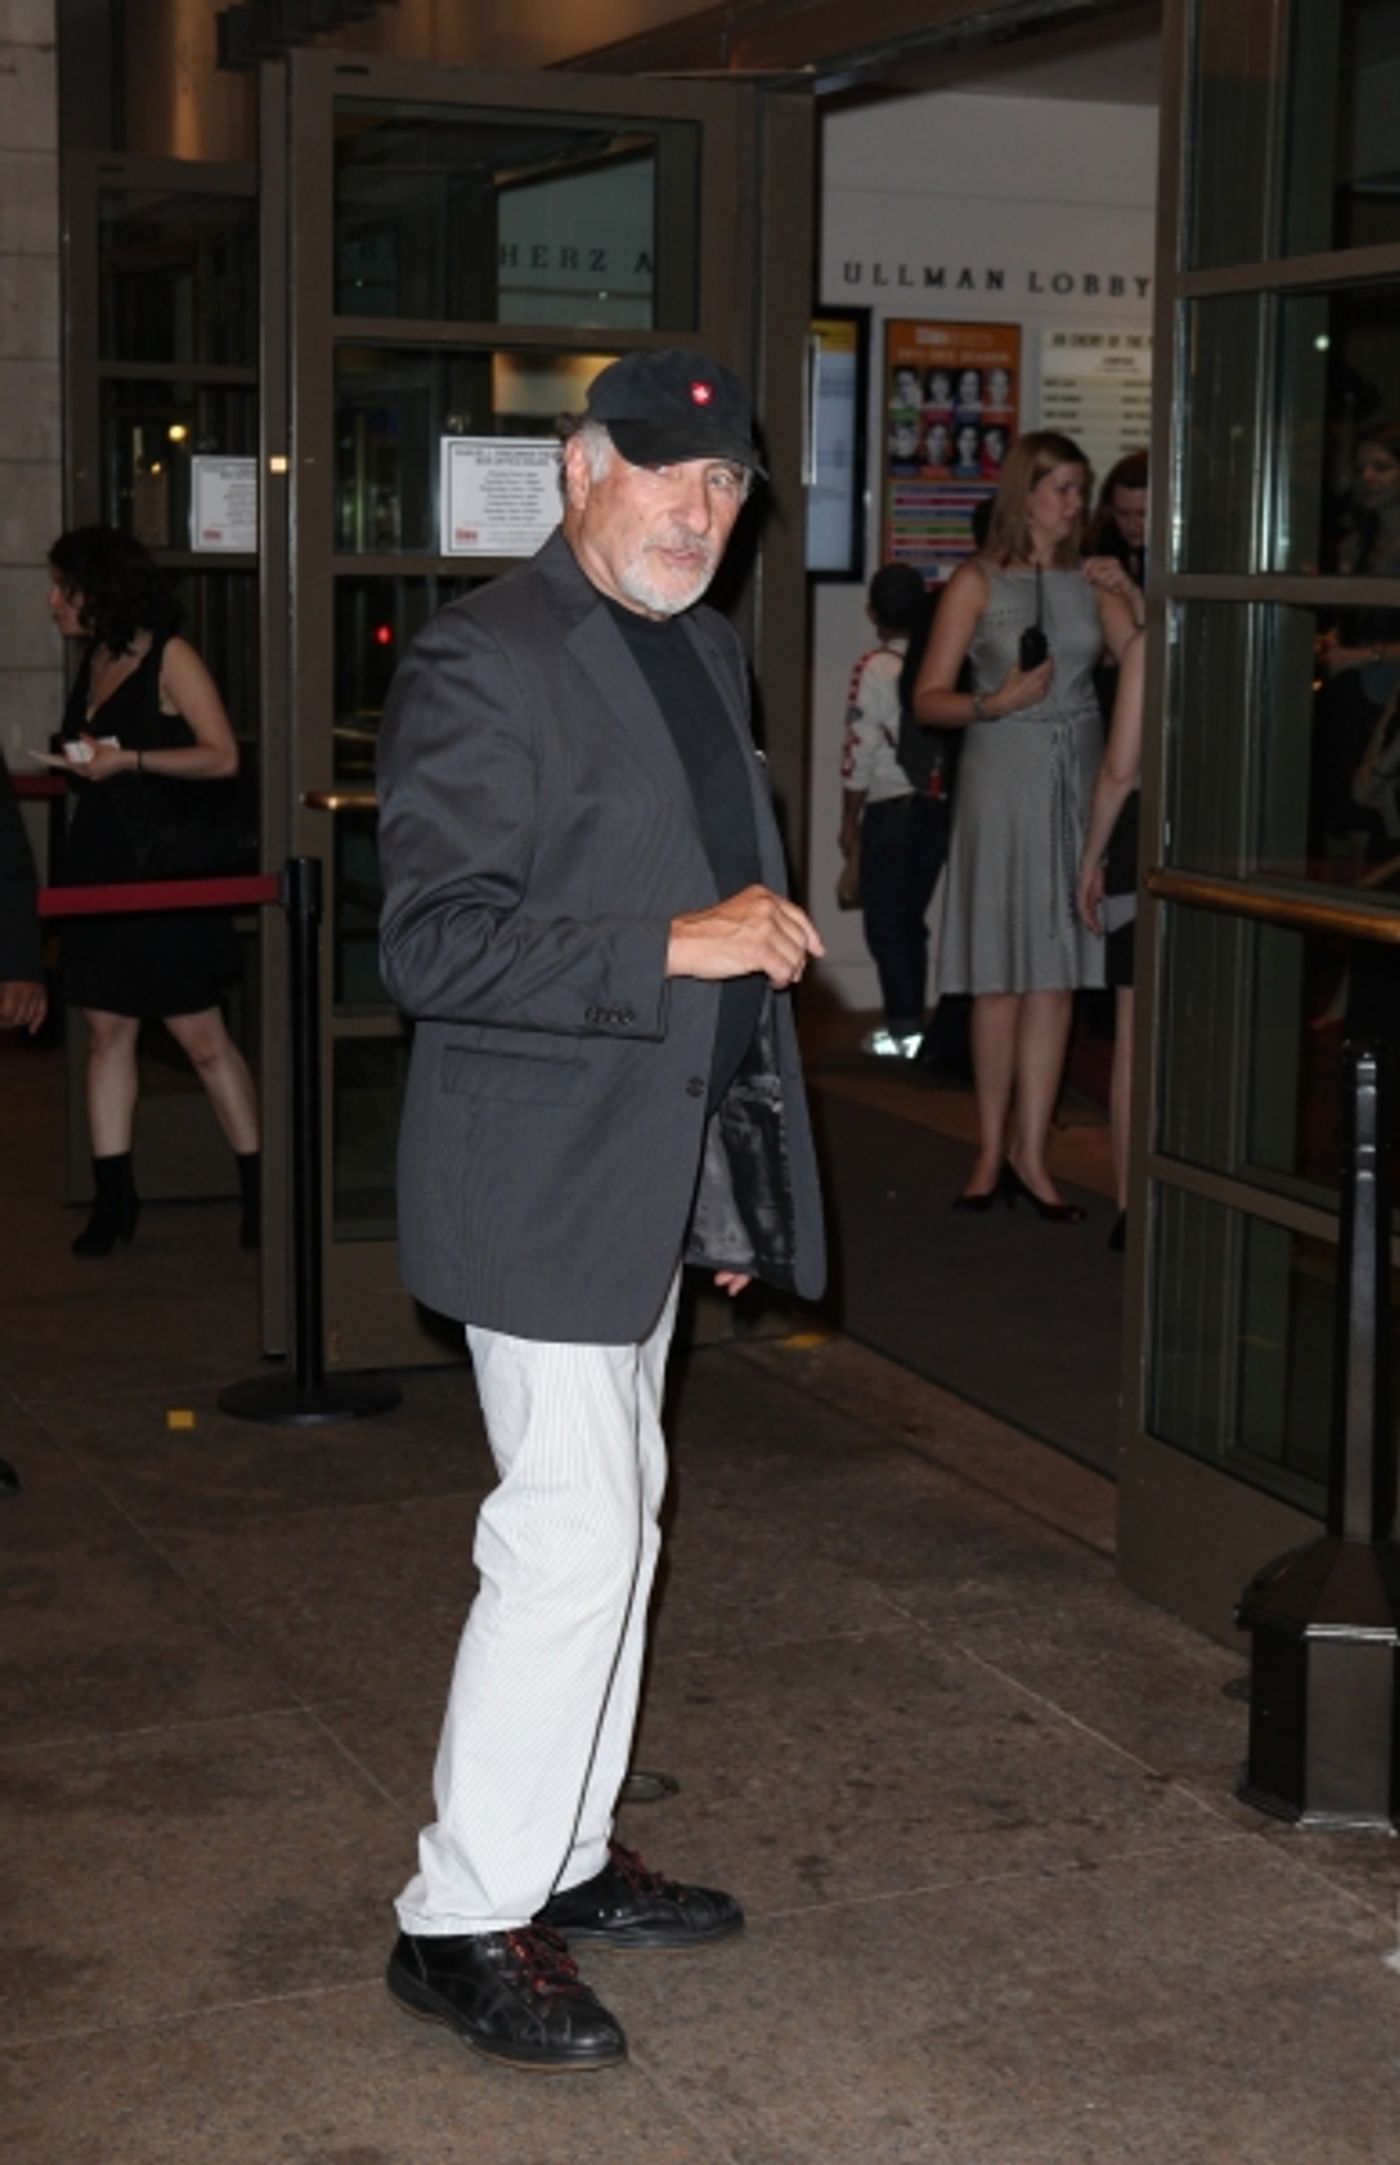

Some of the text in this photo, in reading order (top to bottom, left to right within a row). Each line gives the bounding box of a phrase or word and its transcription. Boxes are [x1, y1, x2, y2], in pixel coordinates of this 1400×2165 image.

[496, 244, 608, 273] HERZ
[843, 261, 1152, 298] ULLMAN LOBBY
